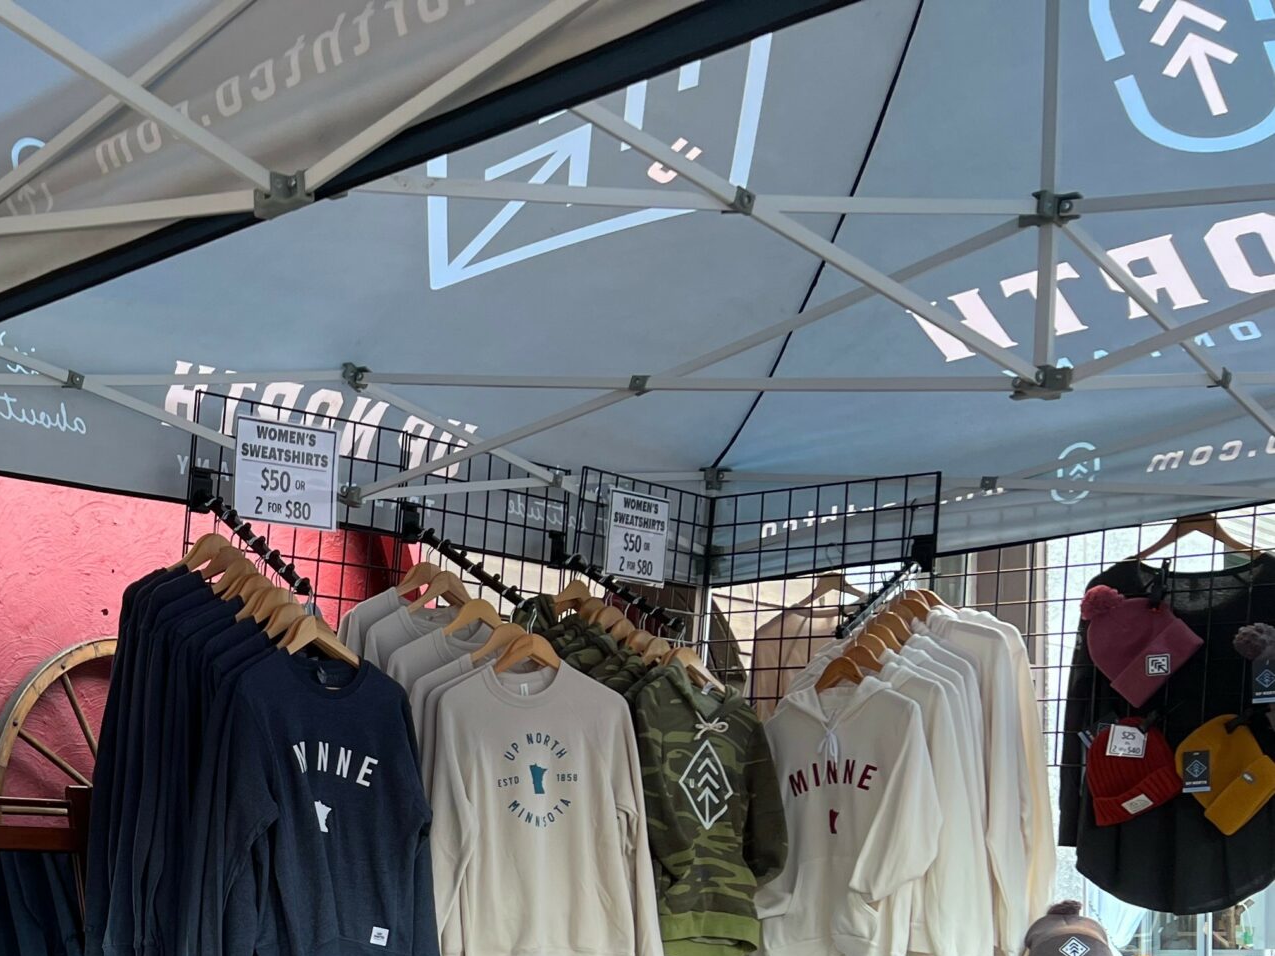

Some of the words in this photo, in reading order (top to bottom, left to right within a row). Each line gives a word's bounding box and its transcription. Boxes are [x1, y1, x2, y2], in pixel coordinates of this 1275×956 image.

[256, 425, 316, 447] WOMEN'S
[241, 442, 328, 468] SWEATSHIRTS
[260, 467, 291, 492] $50
[295, 480, 306, 491] OR
[254, 496, 263, 514] 2
[267, 502, 282, 514] FOR
[285, 499, 311, 520] $80
[623, 496, 659, 515] WOMEN'S
[613, 511, 665, 532] SWEATSHIRTS
[623, 531, 642, 553] $50
[619, 556, 625, 572] 2
[637, 559, 653, 576] $80
[504, 742, 519, 761] UP
[526, 732, 568, 759] NORTH
[497, 776, 519, 788] ESTD
[788, 759, 878, 797] MINNE
